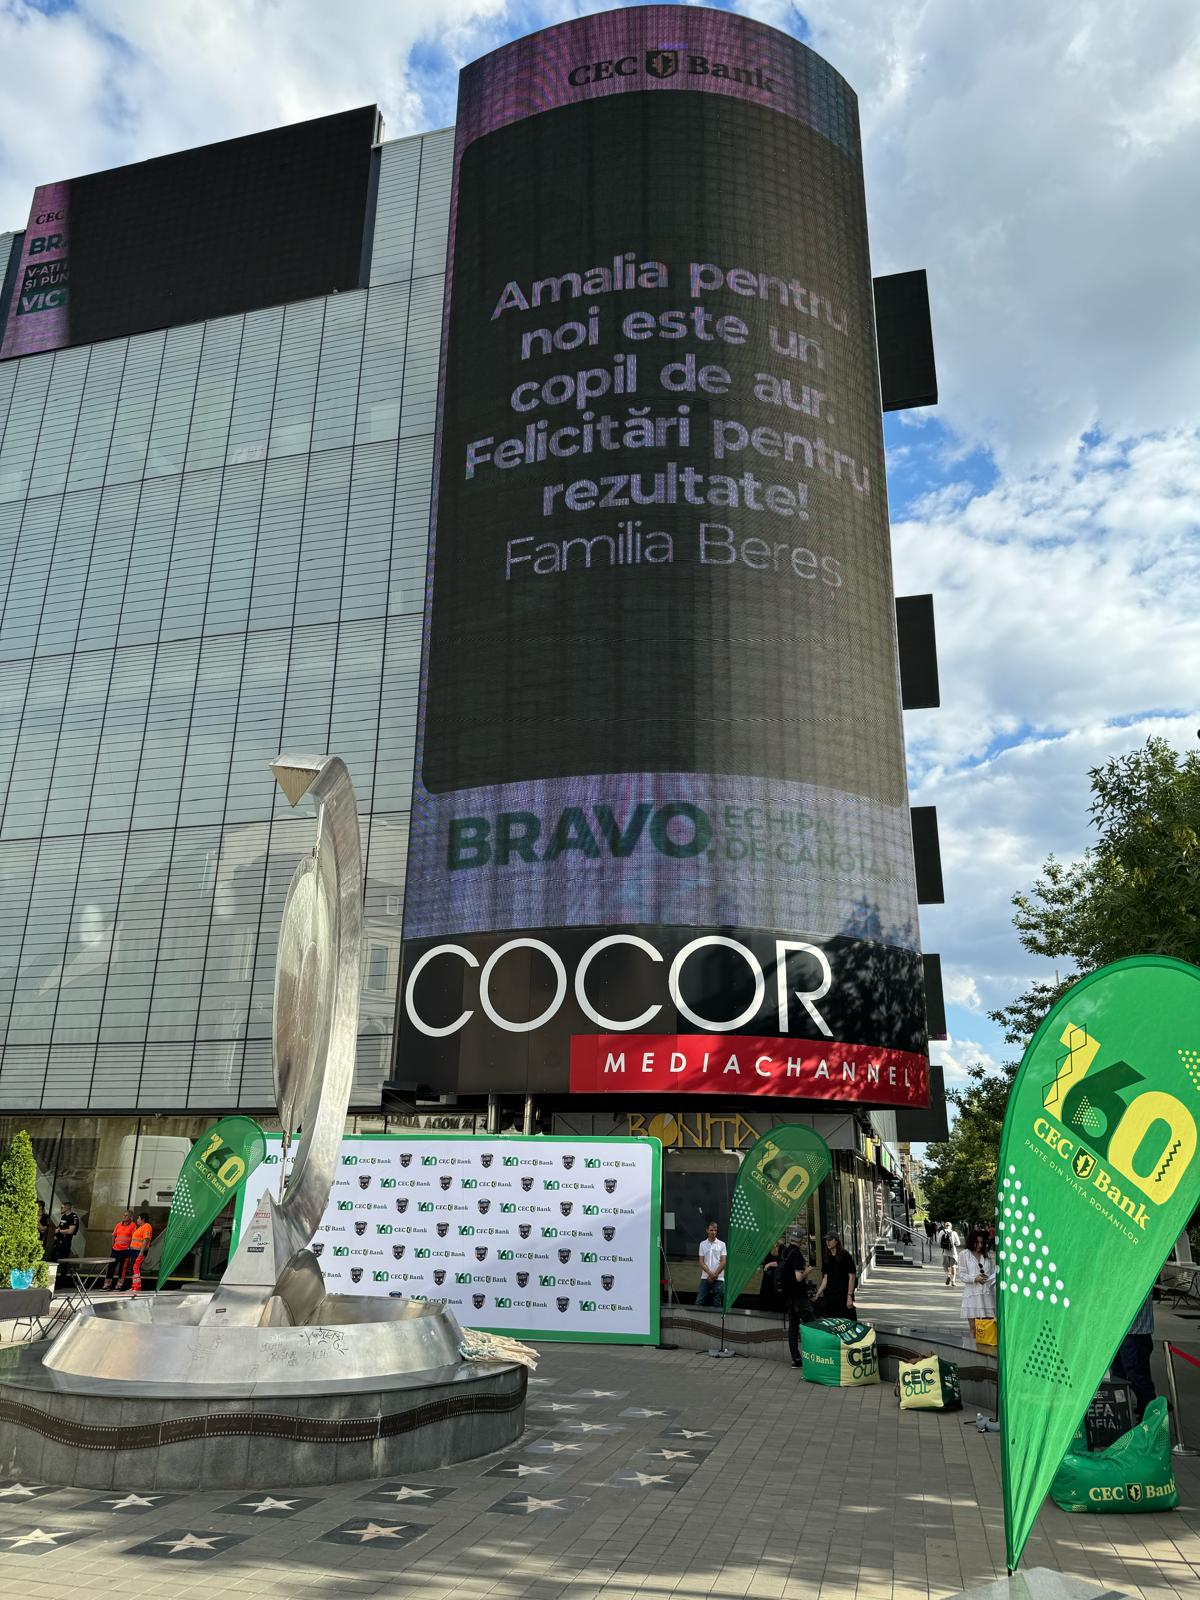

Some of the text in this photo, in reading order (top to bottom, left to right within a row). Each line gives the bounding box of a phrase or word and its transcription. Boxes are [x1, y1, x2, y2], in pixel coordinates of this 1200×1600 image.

[568, 54, 777, 94] CEC Bank
[490, 252, 849, 337] Amalia pentru
[519, 306, 826, 370] noi este un
[510, 354, 836, 424] copil de aur.
[464, 404, 870, 498] Felicitări pentru
[542, 462, 810, 522] rezultate!
[505, 521, 843, 588] Familia Beres
[727, 838, 766, 862] DE
[405, 934, 834, 1038] COCOR
[604, 1052, 912, 1088] MEDIACHANNEL
[1042, 1022, 1198, 1206] 160
[342, 1155, 358, 1165] 160
[420, 1156, 437, 1166] 160
[502, 1156, 518, 1166] 160
[1024, 1138, 1047, 1162] PARTE
[1048, 1161, 1063, 1176] DIN
[584, 1158, 600, 1168] 160
[1032, 1118, 1150, 1231] CEC Bank
[380, 1178, 396, 1188] 160
[461, 1178, 478, 1188] 160
[543, 1180, 560, 1190] 160
[752, 1170, 766, 1185] CEC
[772, 1188, 793, 1208] Bank
[337, 1200, 353, 1210] 160
[417, 1202, 434, 1212] 160
[500, 1202, 516, 1213] 160
[582, 1205, 598, 1215] 160
[376, 1224, 392, 1234] 160
[458, 1226, 474, 1235] 160
[541, 1227, 558, 1237] 160
[332, 1246, 349, 1256] 160
[414, 1248, 430, 1258] 160
[497, 1250, 514, 1260] 160
[580, 1252, 597, 1262] 160
[372, 1271, 389, 1281] 160
[454, 1273, 472, 1283] 160
[539, 1275, 556, 1286] 160
[494, 1297, 512, 1308] 160
[579, 1300, 596, 1311] 160
[816, 1355, 835, 1365] Bank
[902, 1368, 936, 1386] CEC
[1089, 1476, 1176, 1501] CEC Bank
